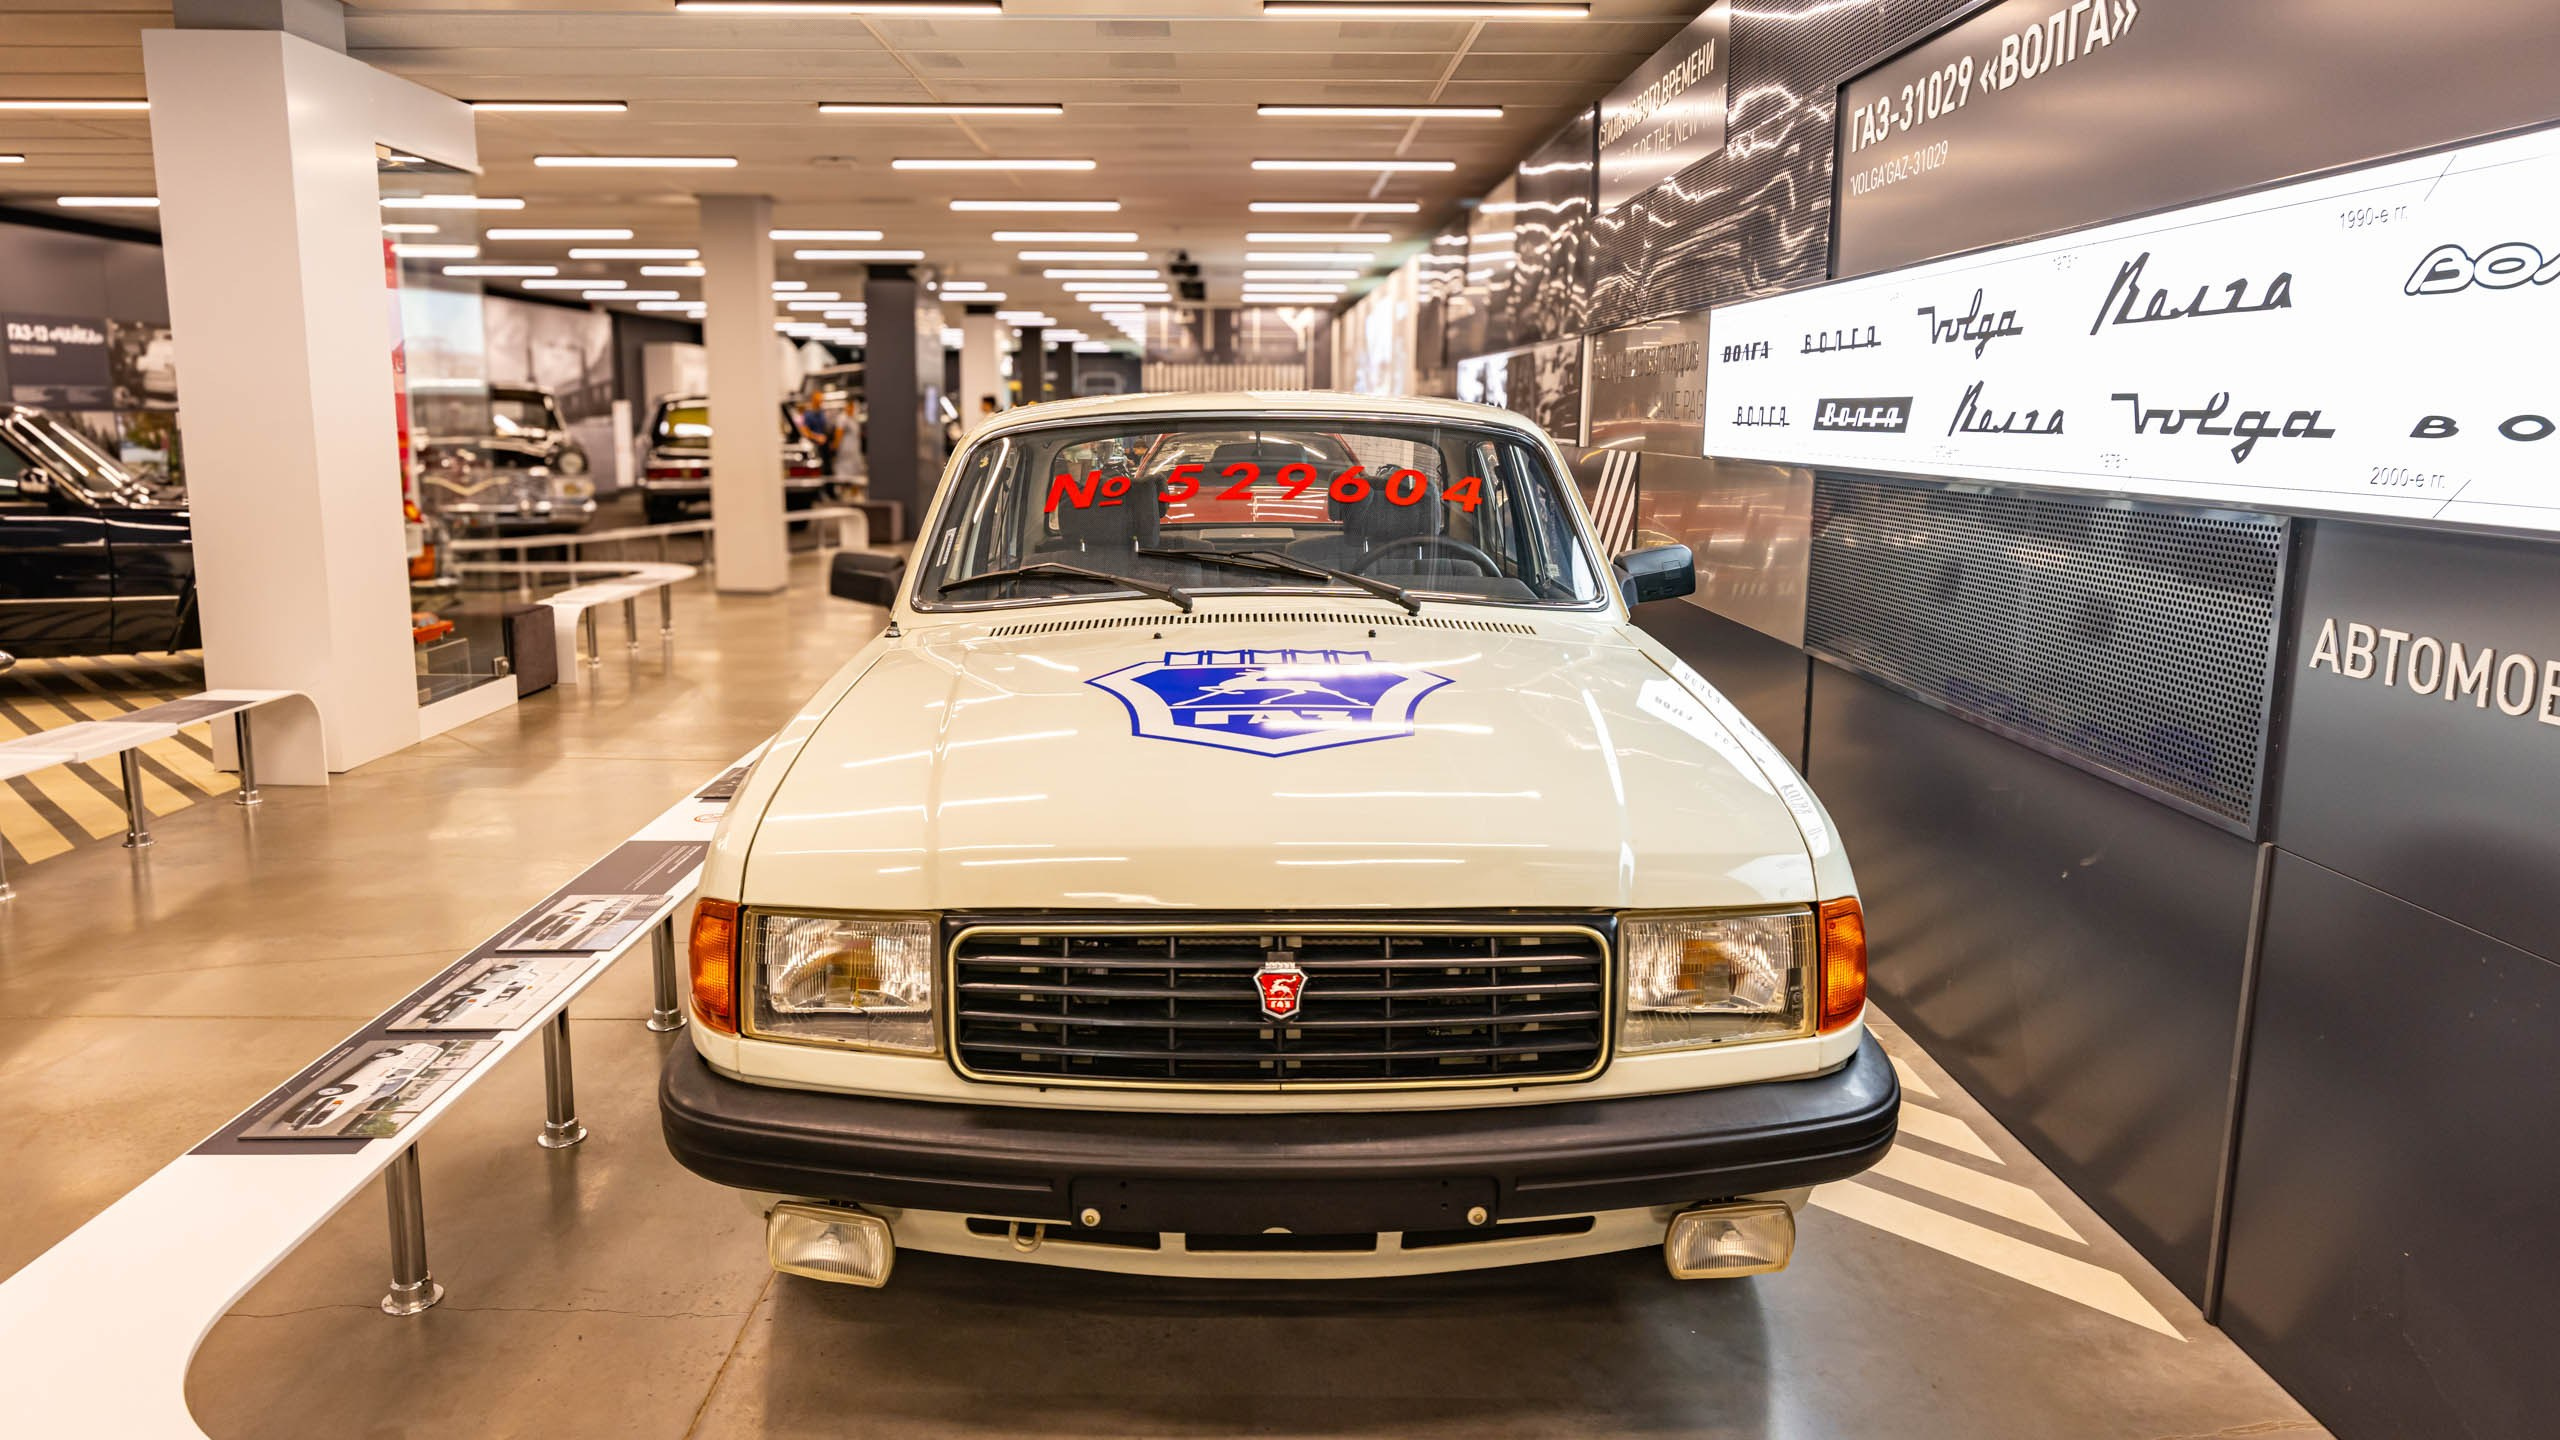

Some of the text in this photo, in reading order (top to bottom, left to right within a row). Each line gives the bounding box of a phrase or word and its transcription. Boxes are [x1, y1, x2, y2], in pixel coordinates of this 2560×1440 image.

[1662, 38, 1715, 106] ВРЕМЕНИ
[1850, 0, 2141, 153] ГАЗ-31029 «ВОЛГА»
[1653, 117, 1672, 154] THE
[1886, 140, 1948, 184] GAZ-31029
[2340, 207, 2389, 231] 1990-е
[2089, 251, 2293, 336] Волга
[1917, 288, 2024, 360] Volga
[1721, 340, 1772, 363] ВОЛГА
[1948, 380, 2064, 437] Волга
[2111, 391, 2336, 465] Volga
[1158, 462, 1483, 512] 529604
[2369, 466, 2425, 488] 2000-е
